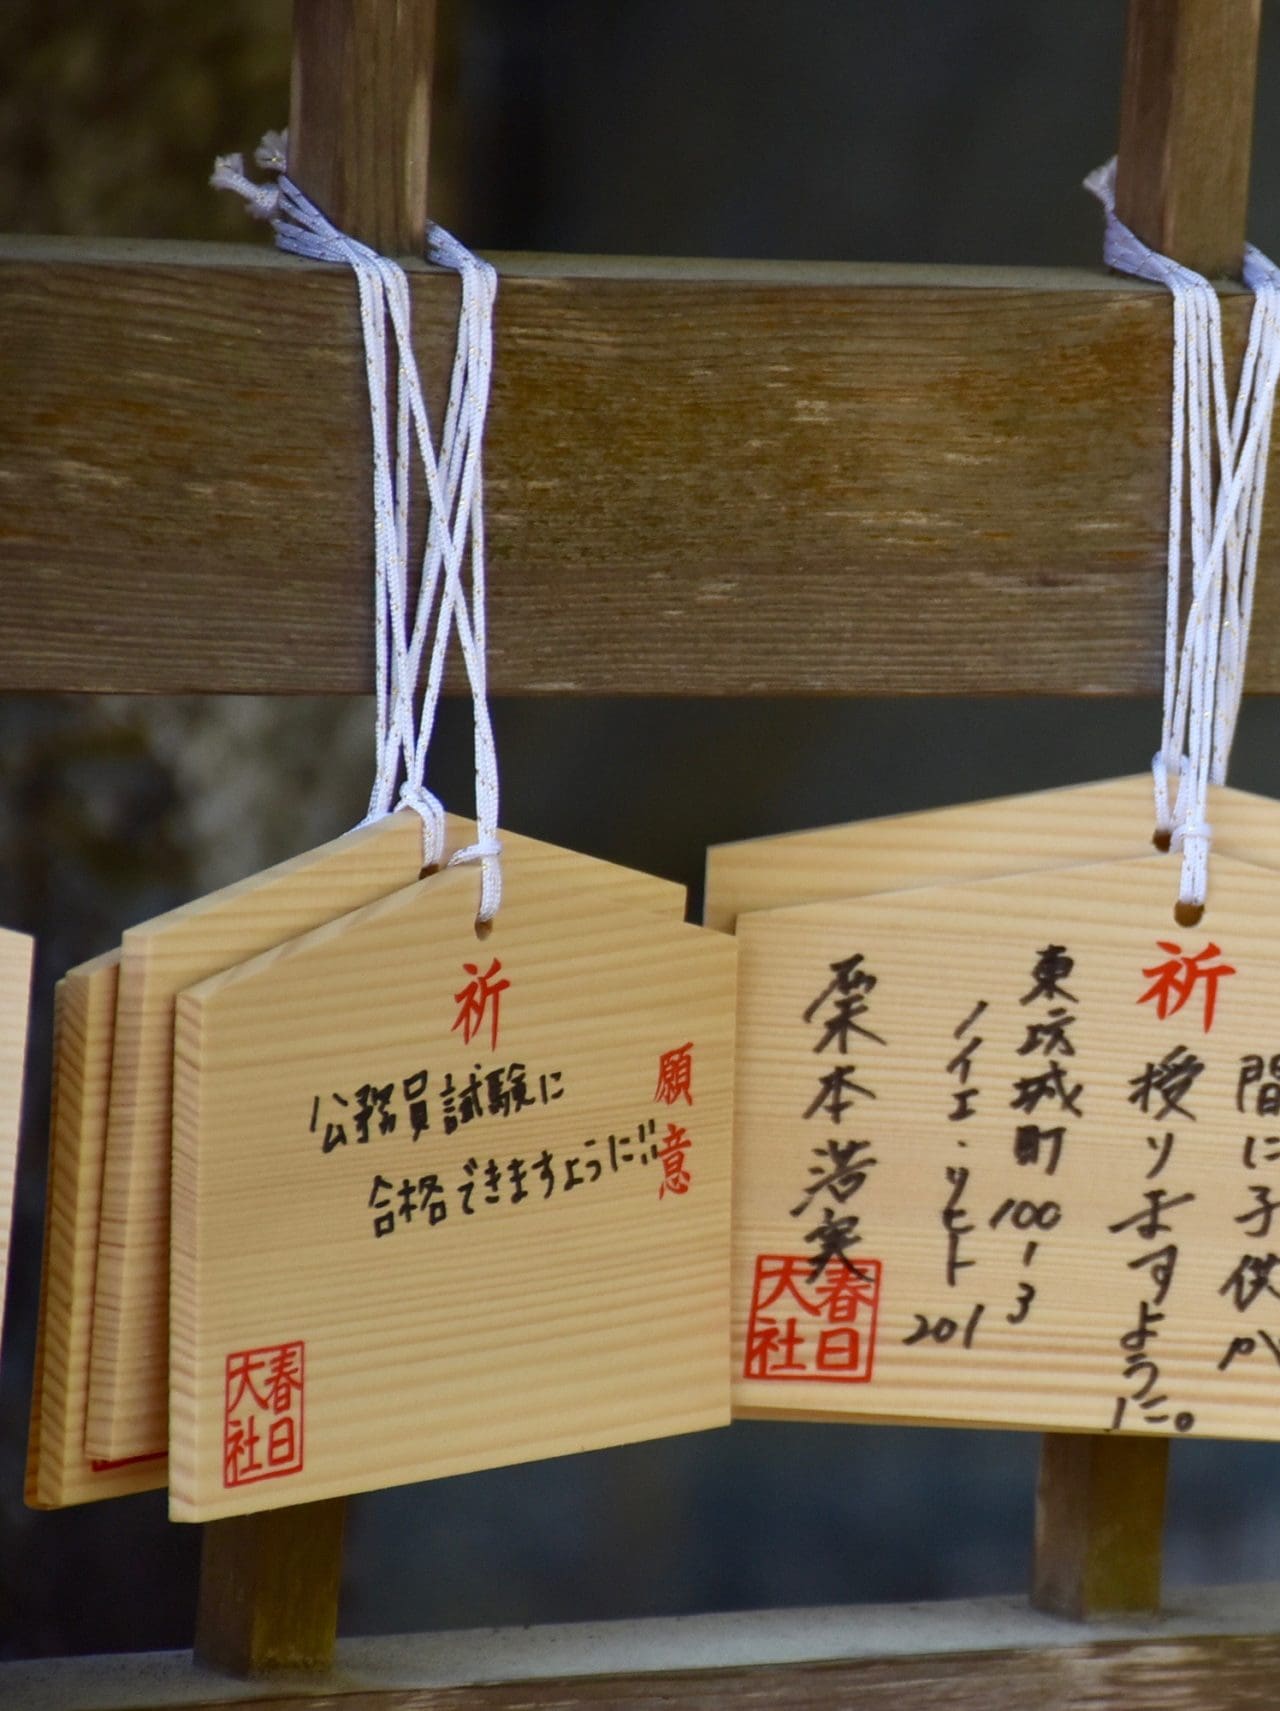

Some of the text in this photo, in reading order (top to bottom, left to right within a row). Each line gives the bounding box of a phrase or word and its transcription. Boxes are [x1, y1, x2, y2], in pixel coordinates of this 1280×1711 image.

[451, 958, 511, 1051] 祈
[1137, 941, 1237, 1033] 祈
[309, 1062, 565, 1154] 公務員試験に
[654, 1041, 694, 1202] 願意
